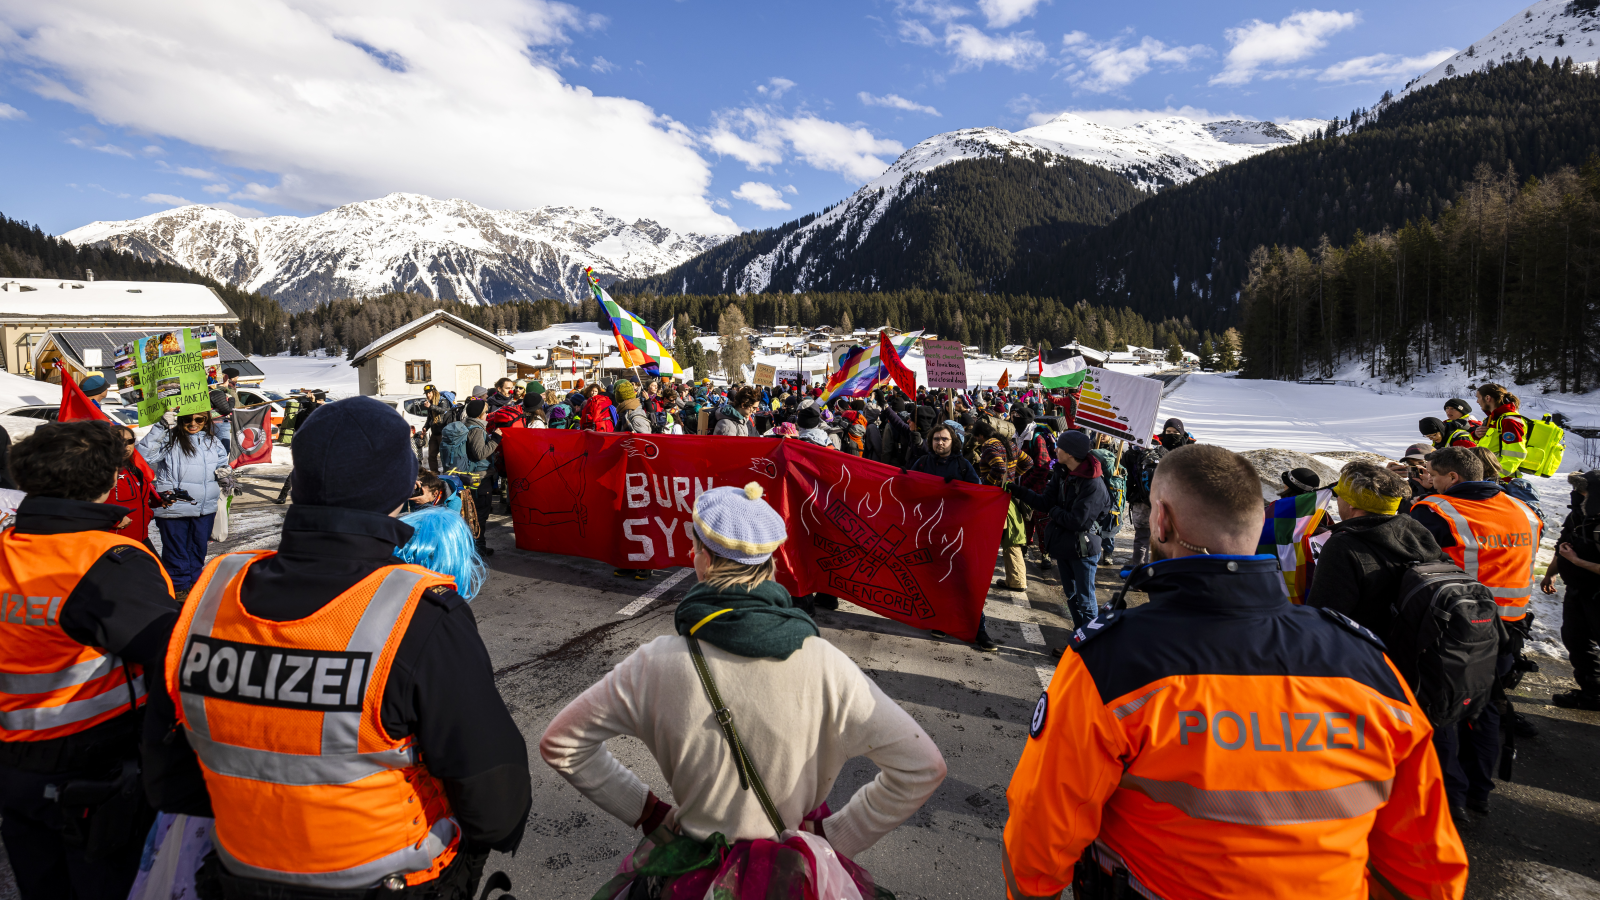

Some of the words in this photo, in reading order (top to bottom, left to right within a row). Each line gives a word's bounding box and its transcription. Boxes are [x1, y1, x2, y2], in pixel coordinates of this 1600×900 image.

[142, 363, 155, 374] DER
[158, 351, 202, 368] AMAZONAS
[142, 371, 155, 385] DARF
[157, 366, 172, 377] NICHT
[174, 362, 205, 374] STERBEN
[183, 381, 200, 390] HAY
[140, 402, 160, 417] FUTURO
[161, 398, 171, 408] SIN
[175, 391, 208, 405] PLANETA
[625, 472, 714, 514] BURN
[817, 536, 842, 554] VISA
[1476, 532, 1531, 549] POLIZEI
[859, 537, 900, 577] SHELL
[904, 550, 930, 564] ENI
[834, 576, 911, 610] GLENCORE
[891, 561, 930, 616] SYNGENTA
[183, 641, 366, 706] POLIZEI
[1178, 710, 1366, 752] POLIZEI
